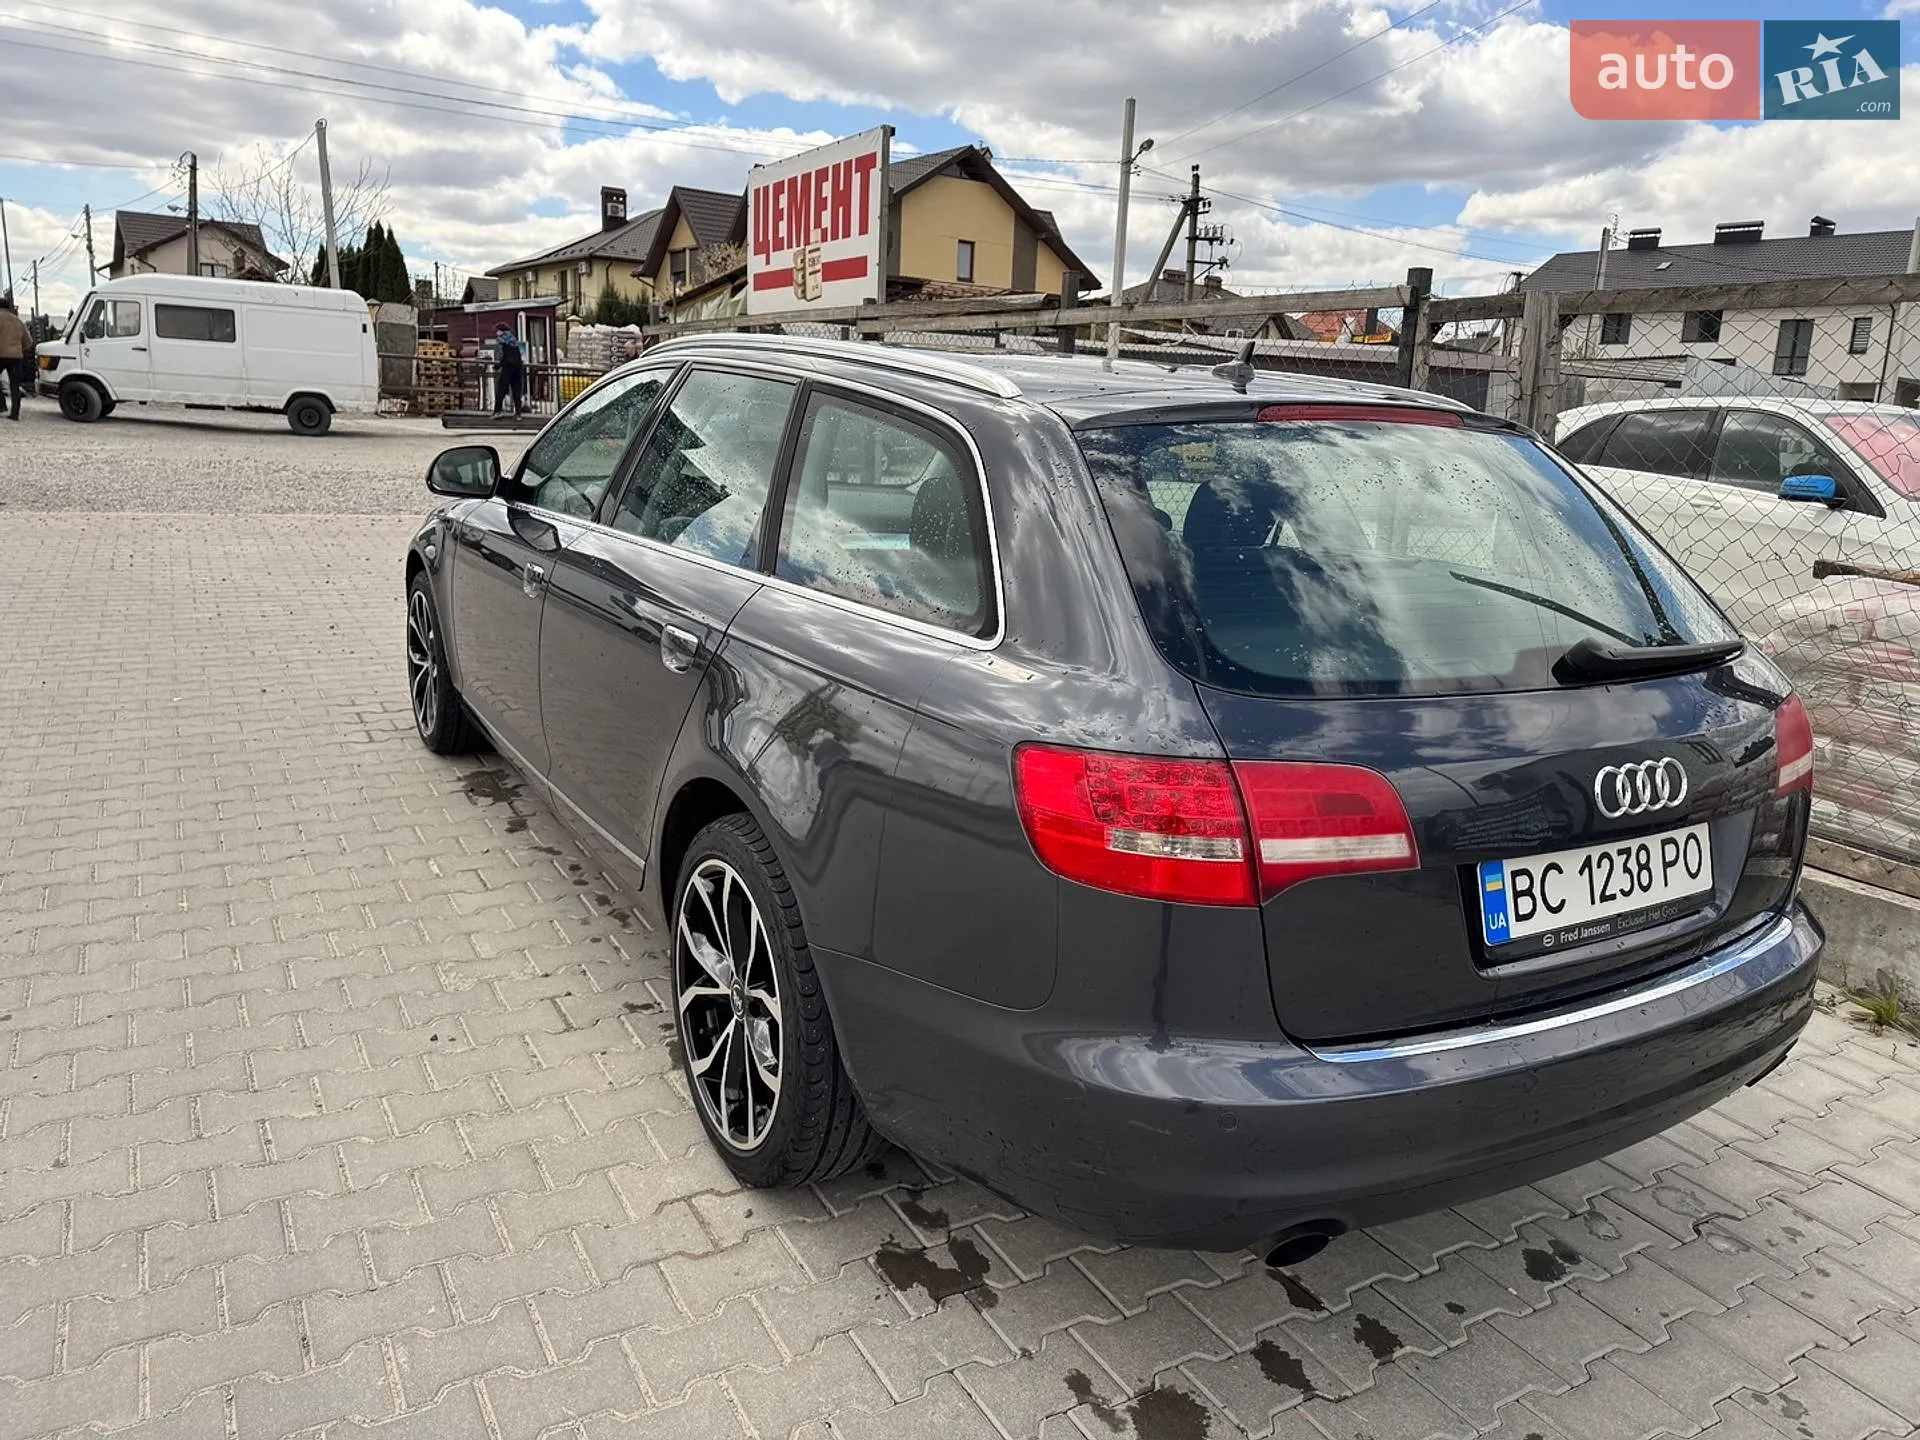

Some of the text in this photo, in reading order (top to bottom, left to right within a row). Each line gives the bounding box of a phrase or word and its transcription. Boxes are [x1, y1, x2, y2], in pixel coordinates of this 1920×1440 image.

[753, 151, 877, 266] ЦЕМЕНТ
[1510, 832, 1703, 922] BC 1238 PO
[1489, 911, 1507, 930] UA
[1560, 928, 1579, 943] Fred
